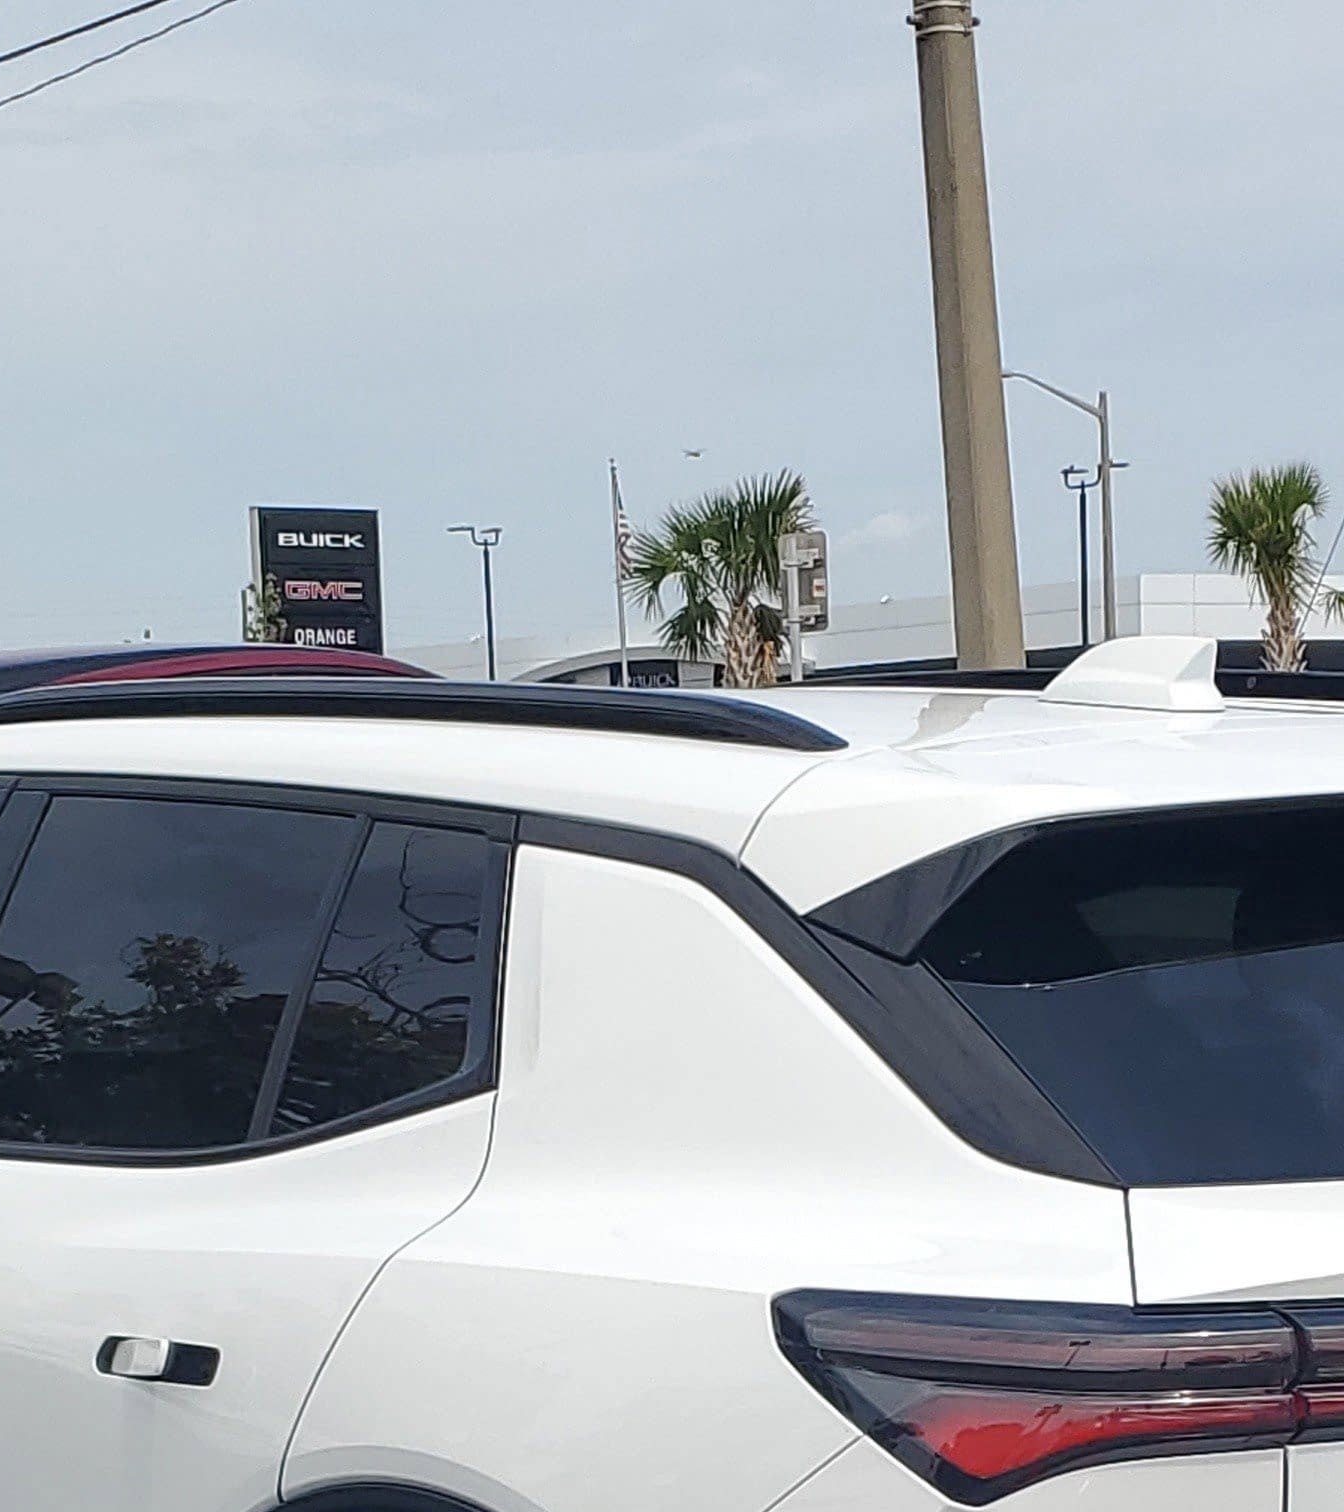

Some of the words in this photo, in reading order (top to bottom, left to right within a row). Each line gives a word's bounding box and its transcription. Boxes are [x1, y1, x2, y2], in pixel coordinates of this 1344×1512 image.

[278, 532, 365, 548] BUICK
[284, 580, 363, 601] GMC
[294, 628, 357, 646] ORANGE
